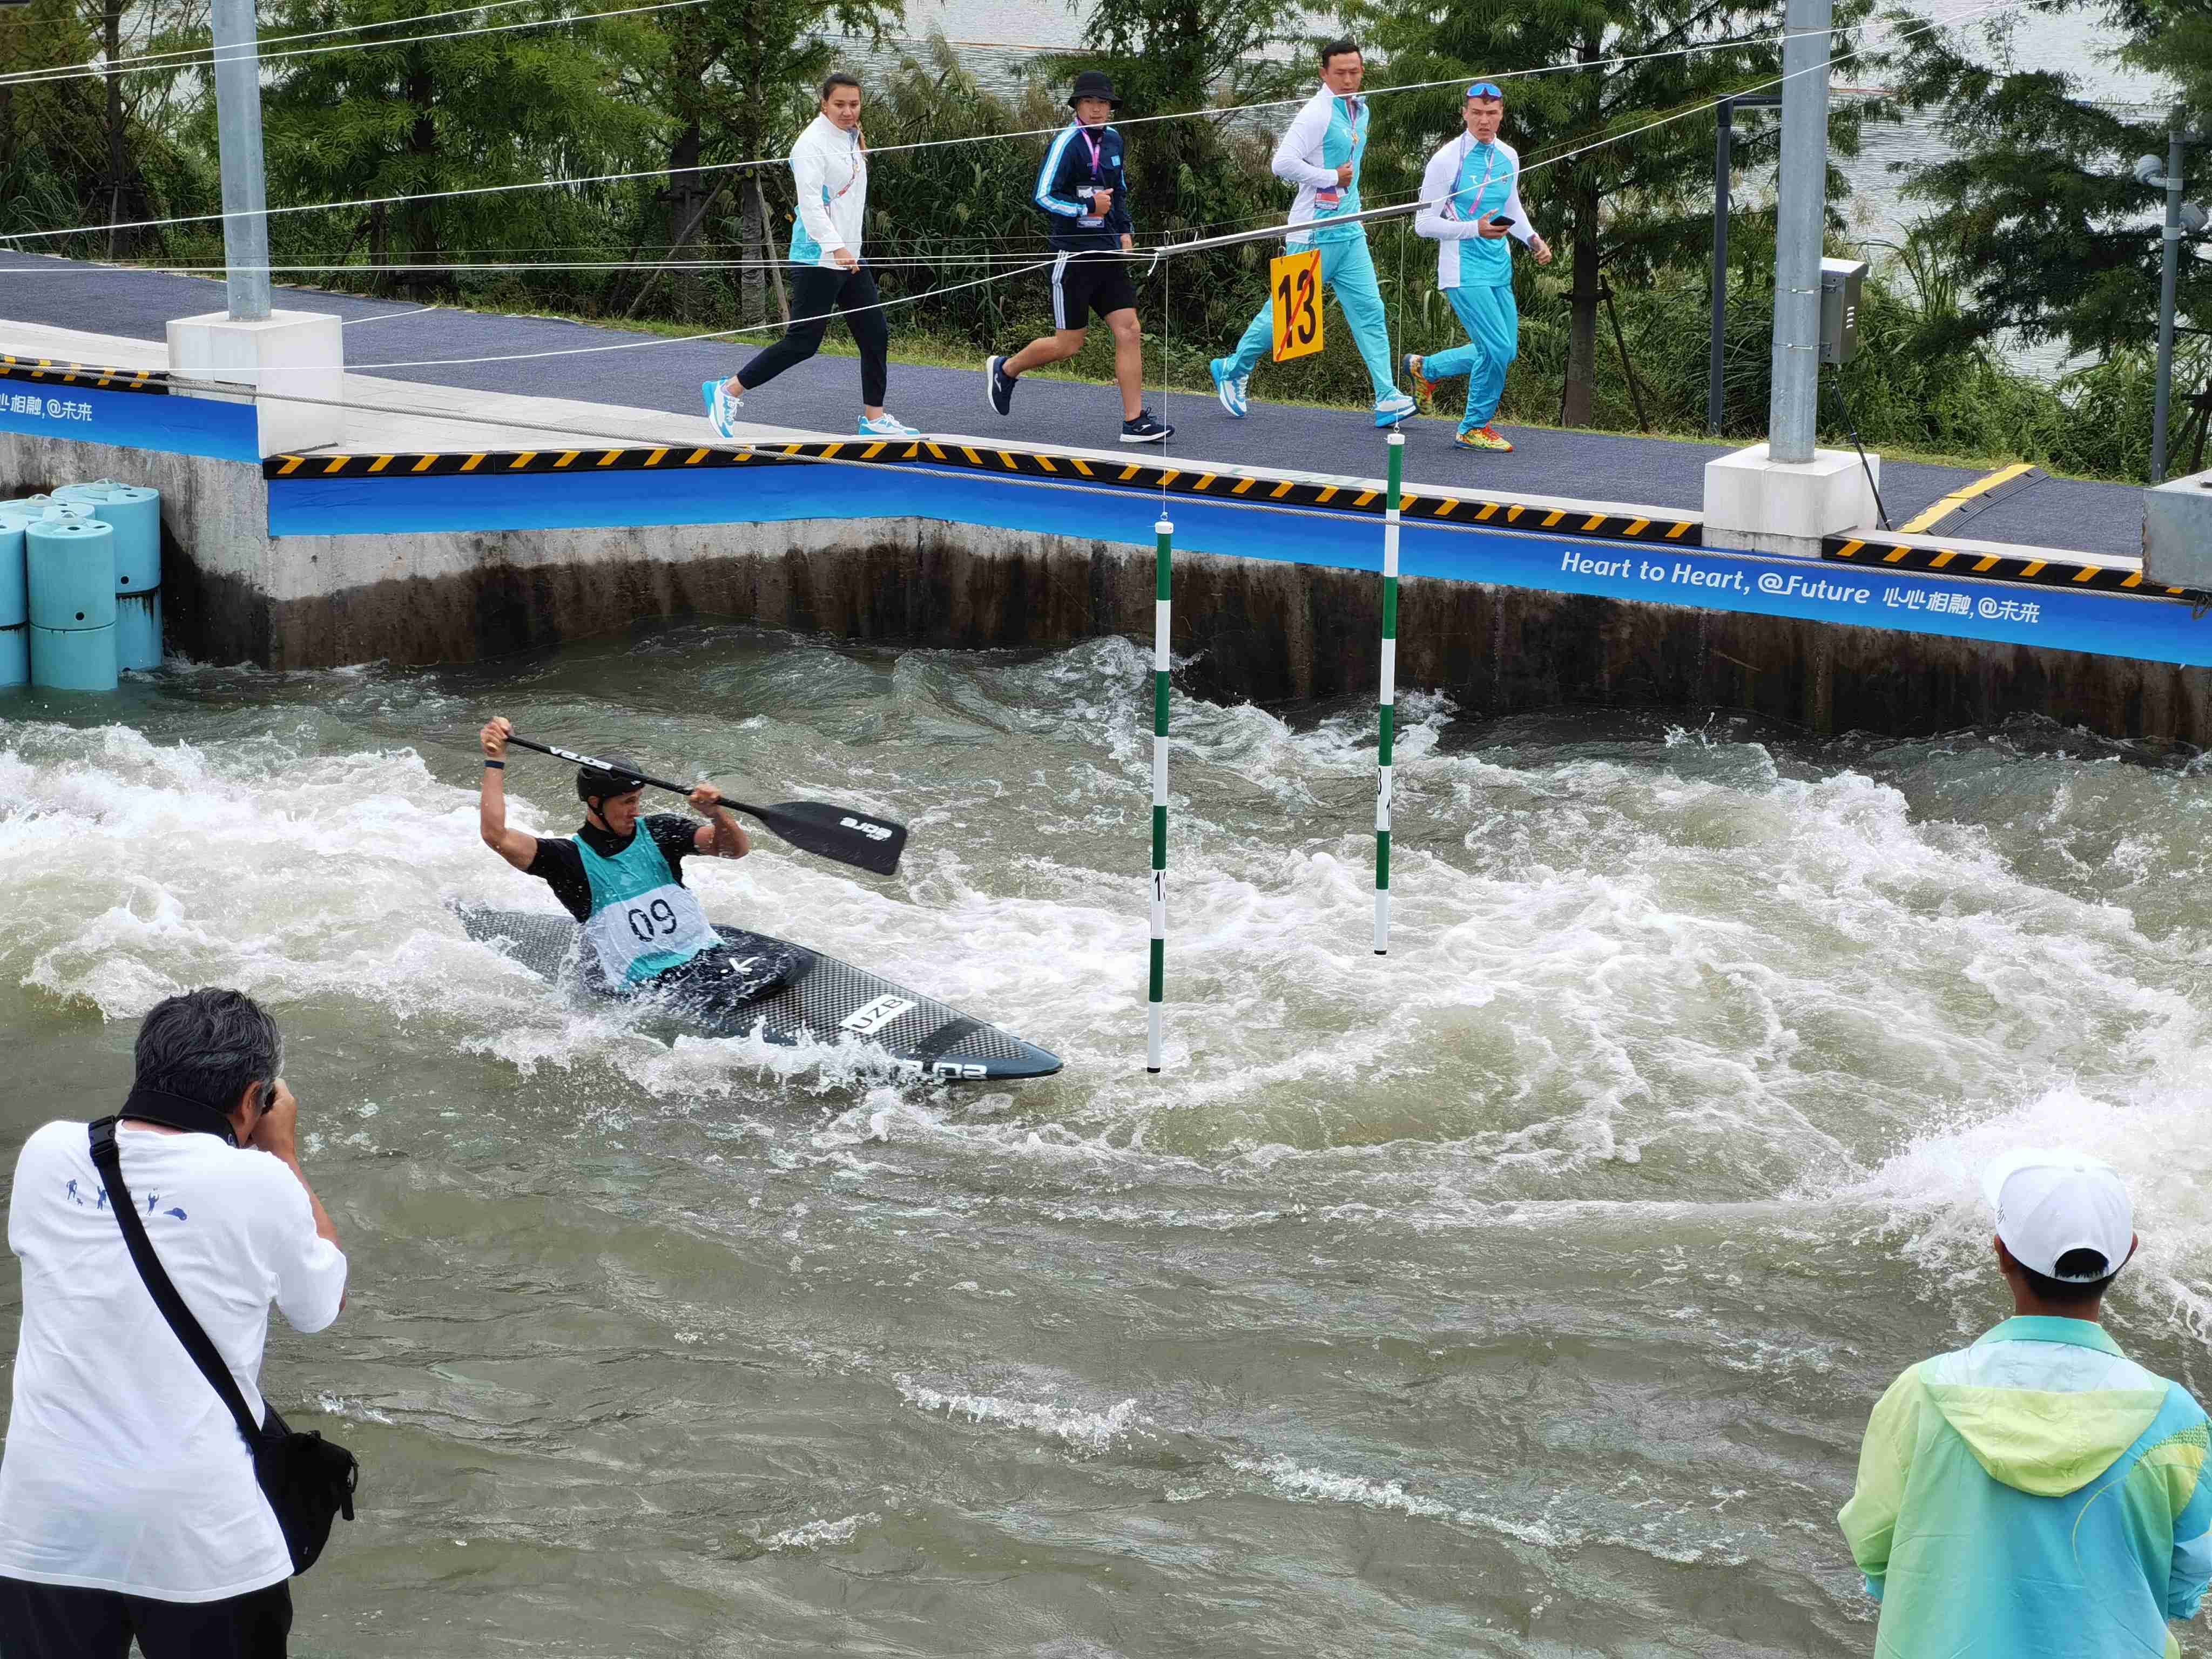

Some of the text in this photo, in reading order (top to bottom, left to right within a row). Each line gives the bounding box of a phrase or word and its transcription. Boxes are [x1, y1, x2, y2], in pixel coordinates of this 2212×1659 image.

[1278, 269, 1316, 348] 13
[1561, 552, 1870, 604] Heart to Heart, @Future
[629, 899, 677, 942] 09
[852, 999, 903, 1029] UZB
